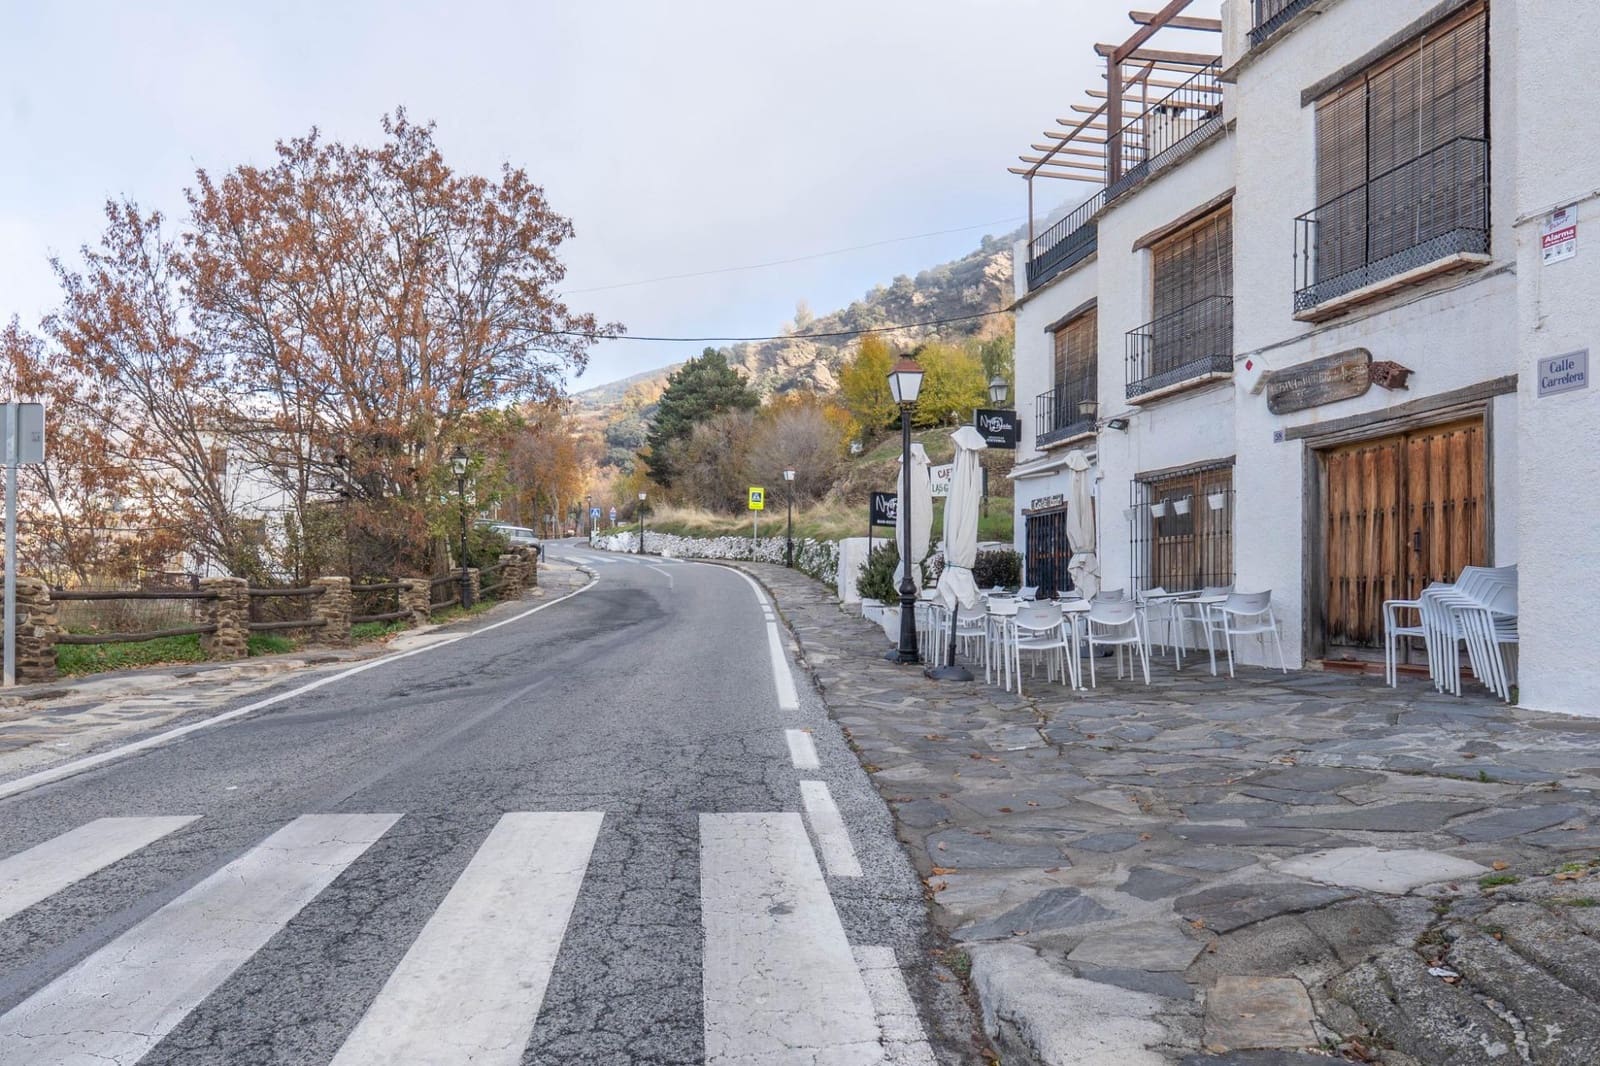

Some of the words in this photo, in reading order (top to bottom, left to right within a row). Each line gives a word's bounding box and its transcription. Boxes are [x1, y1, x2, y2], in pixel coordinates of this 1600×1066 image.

[1544, 229, 1575, 243] Alarma
[1550, 359, 1575, 373] Calle
[1542, 372, 1584, 389] Carretera
